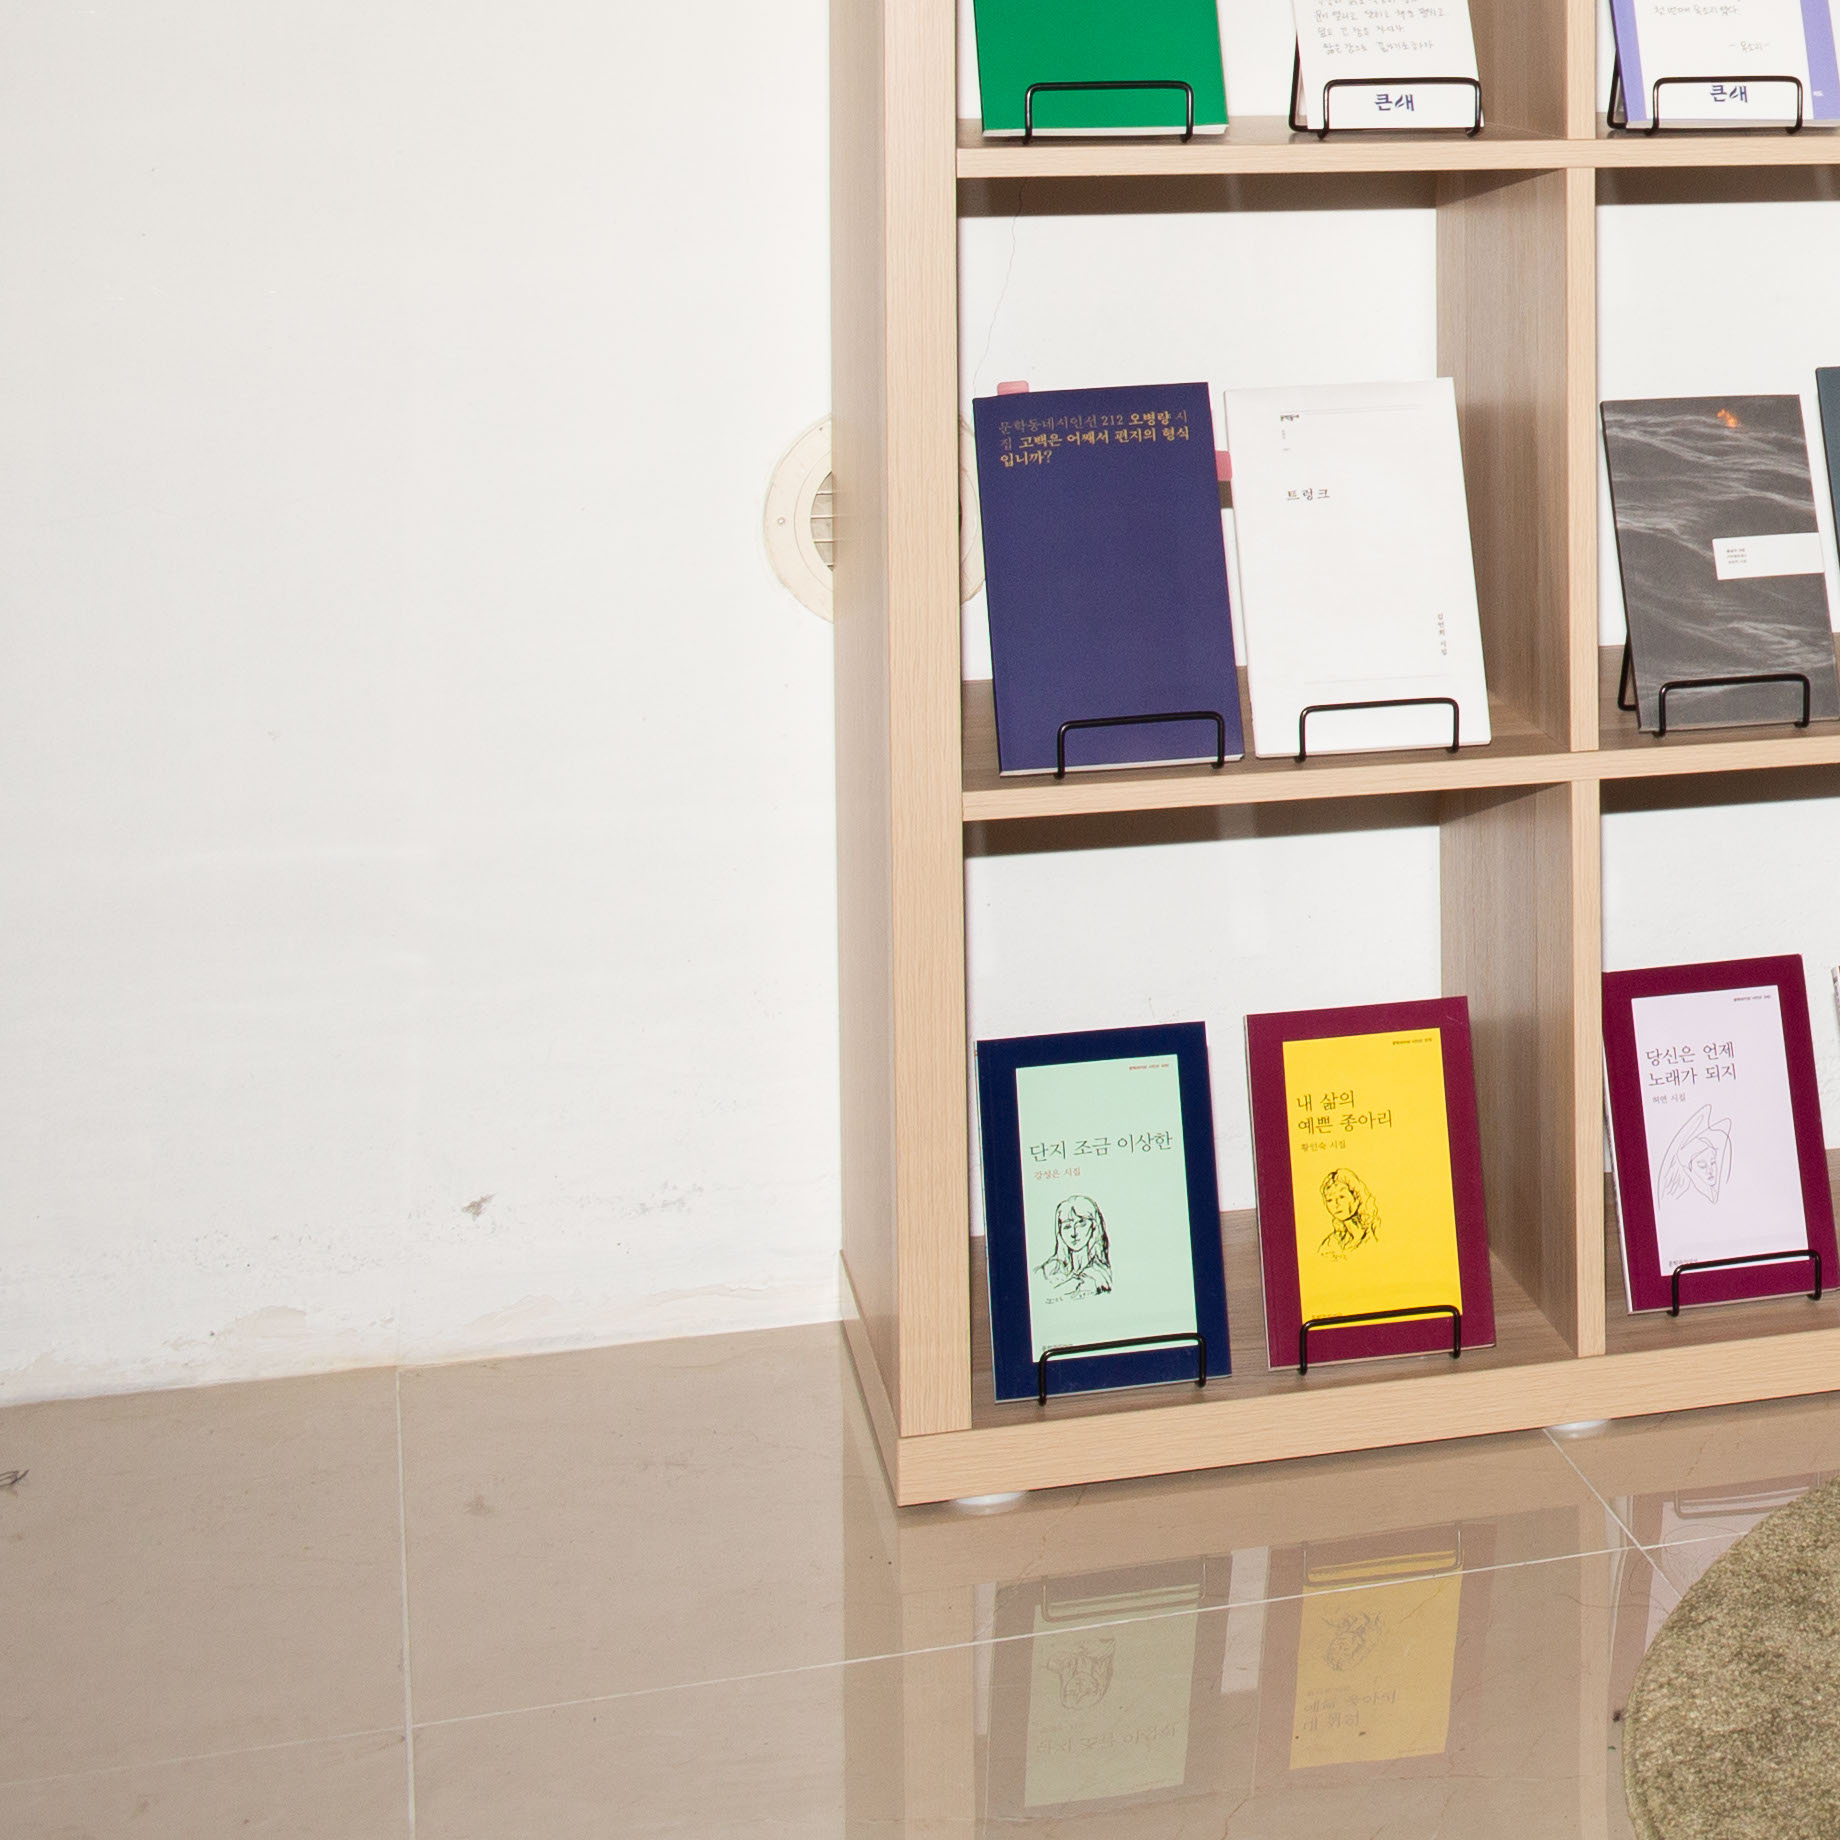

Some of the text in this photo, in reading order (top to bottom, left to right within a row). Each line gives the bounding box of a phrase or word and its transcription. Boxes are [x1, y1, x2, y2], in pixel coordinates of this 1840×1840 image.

[1375, 94, 1414, 111] 큰새
[1710, 85, 1748, 103] 큰새
[1101, 415, 1123, 426] 212
[1018, 426, 1189, 449] 고백은 어째서 편지의 형식
[1000, 450, 1052, 468] 입니까?
[1287, 487, 1331, 501] 트렁크
[1645, 1041, 1735, 1066] 당신은 언제
[1647, 1062, 1737, 1088] 노래가 되지
[1296, 1089, 1356, 1113] 내 삶의
[1297, 1110, 1393, 1137] 예쁜 종아리
[1029, 1130, 1174, 1164] 단지 조금 이상한
[1033, 1166, 1081, 1182] 강성은 시집
